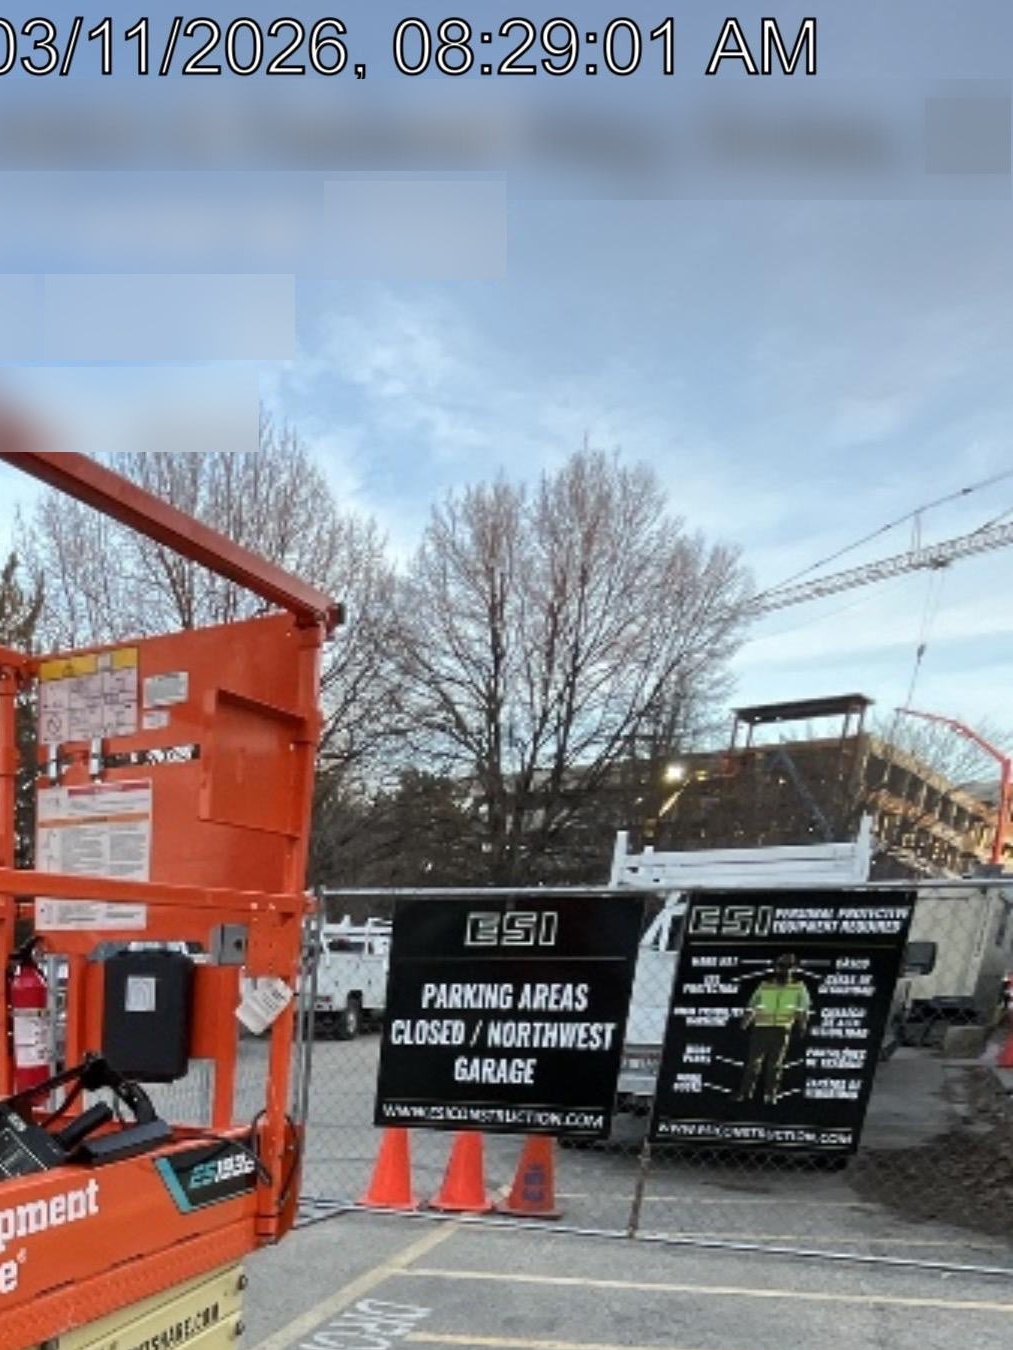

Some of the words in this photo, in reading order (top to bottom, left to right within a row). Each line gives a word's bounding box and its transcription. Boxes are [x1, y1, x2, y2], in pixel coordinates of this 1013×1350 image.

[464, 911, 558, 946] ESI
[689, 905, 774, 937] ESI
[421, 983, 514, 1010] PARKING
[517, 984, 590, 1012] AREAS
[390, 1019, 466, 1046] CLOSED
[487, 1022, 617, 1051] NORTHWEST
[453, 1056, 538, 1085] GARAGE
